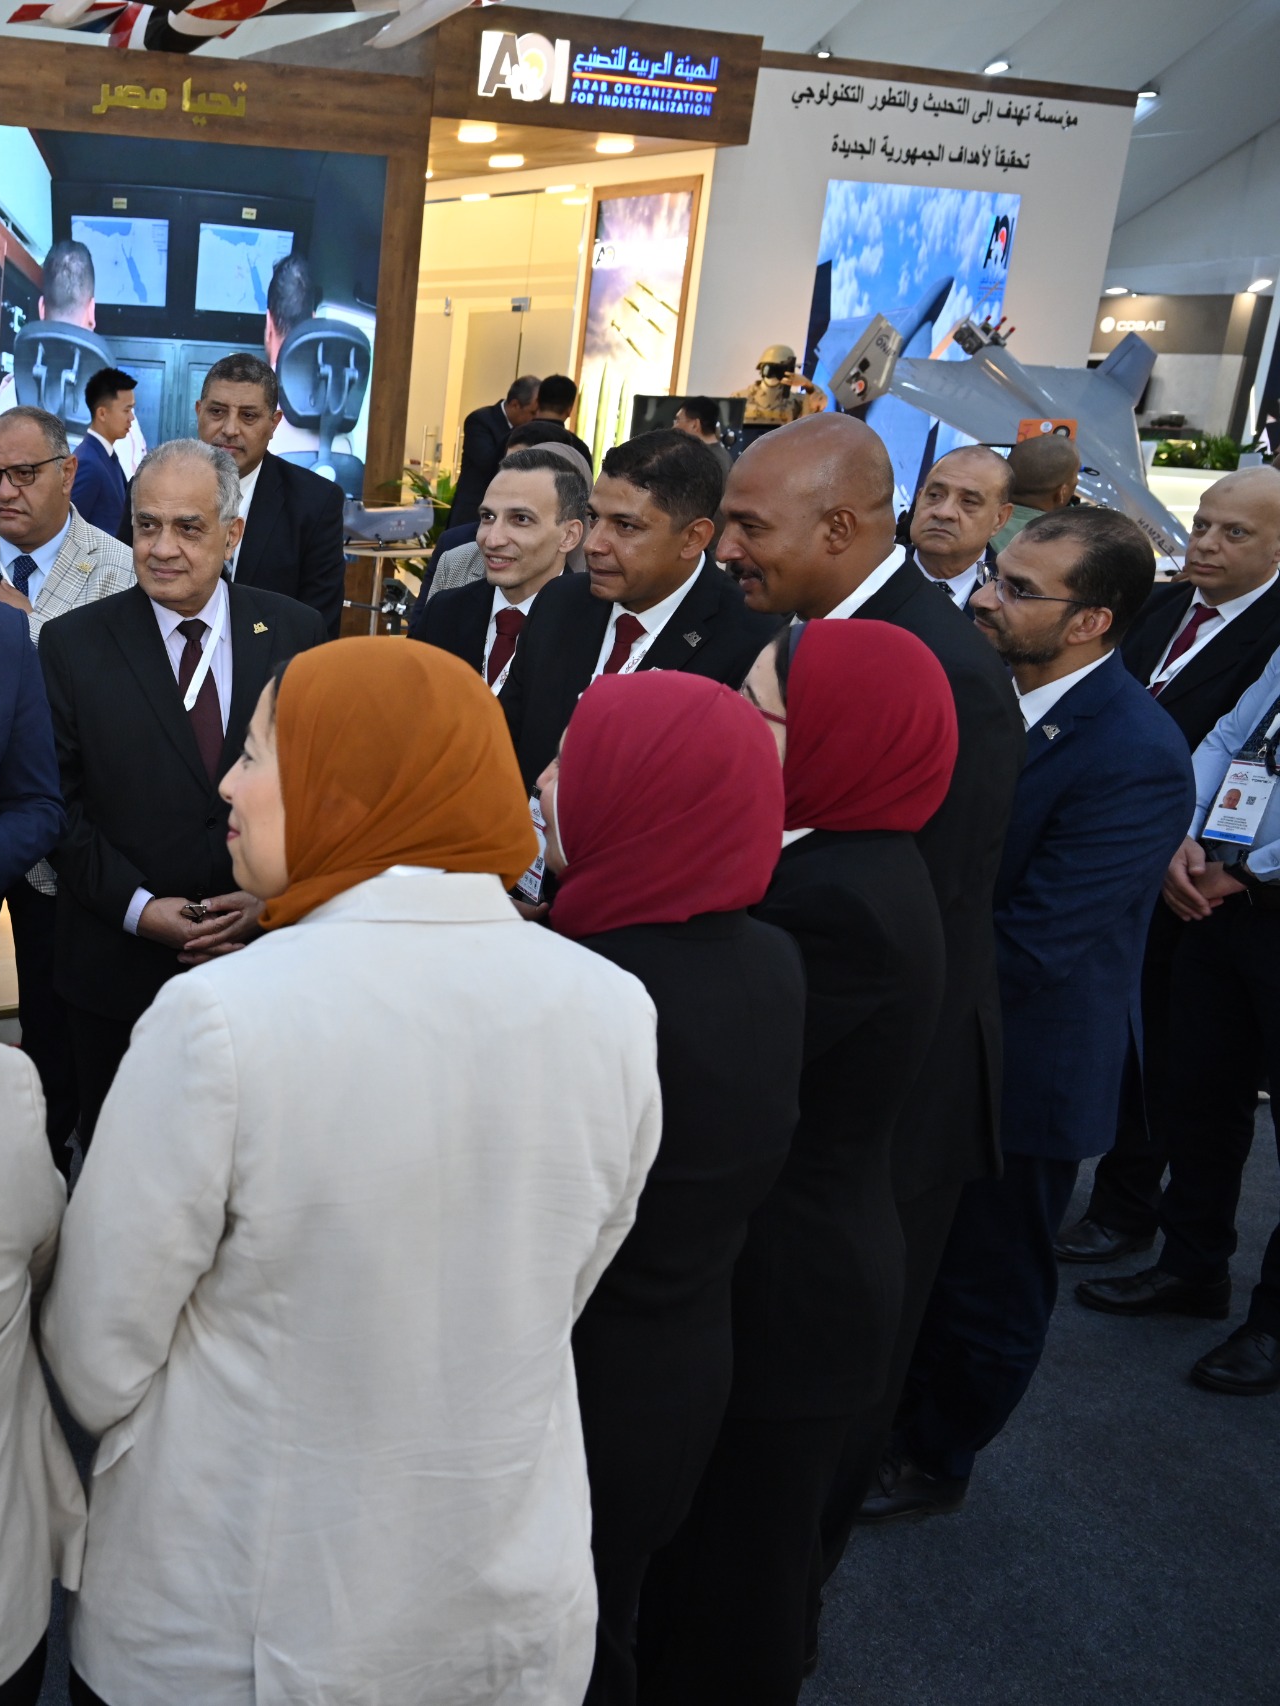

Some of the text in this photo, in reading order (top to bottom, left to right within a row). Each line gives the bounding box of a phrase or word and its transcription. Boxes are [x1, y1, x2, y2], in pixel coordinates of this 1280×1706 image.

[572, 46, 719, 81] الهيئة العربية للتصنيع
[92, 77, 248, 127] تحيا مصر
[570, 92, 712, 117] FOR INDUSTRIALIZATION
[571, 79, 714, 104] ARAB ORGANIZATION
[791, 81, 864, 109] التكنولوجي
[867, 87, 918, 113] والتطور
[922, 93, 970, 117] التحديث
[996, 101, 1030, 127] تهدف
[1034, 102, 1079, 129] مؤسسة
[831, 133, 876, 161] الجديدة
[880, 135, 944, 166] الجمهورية
